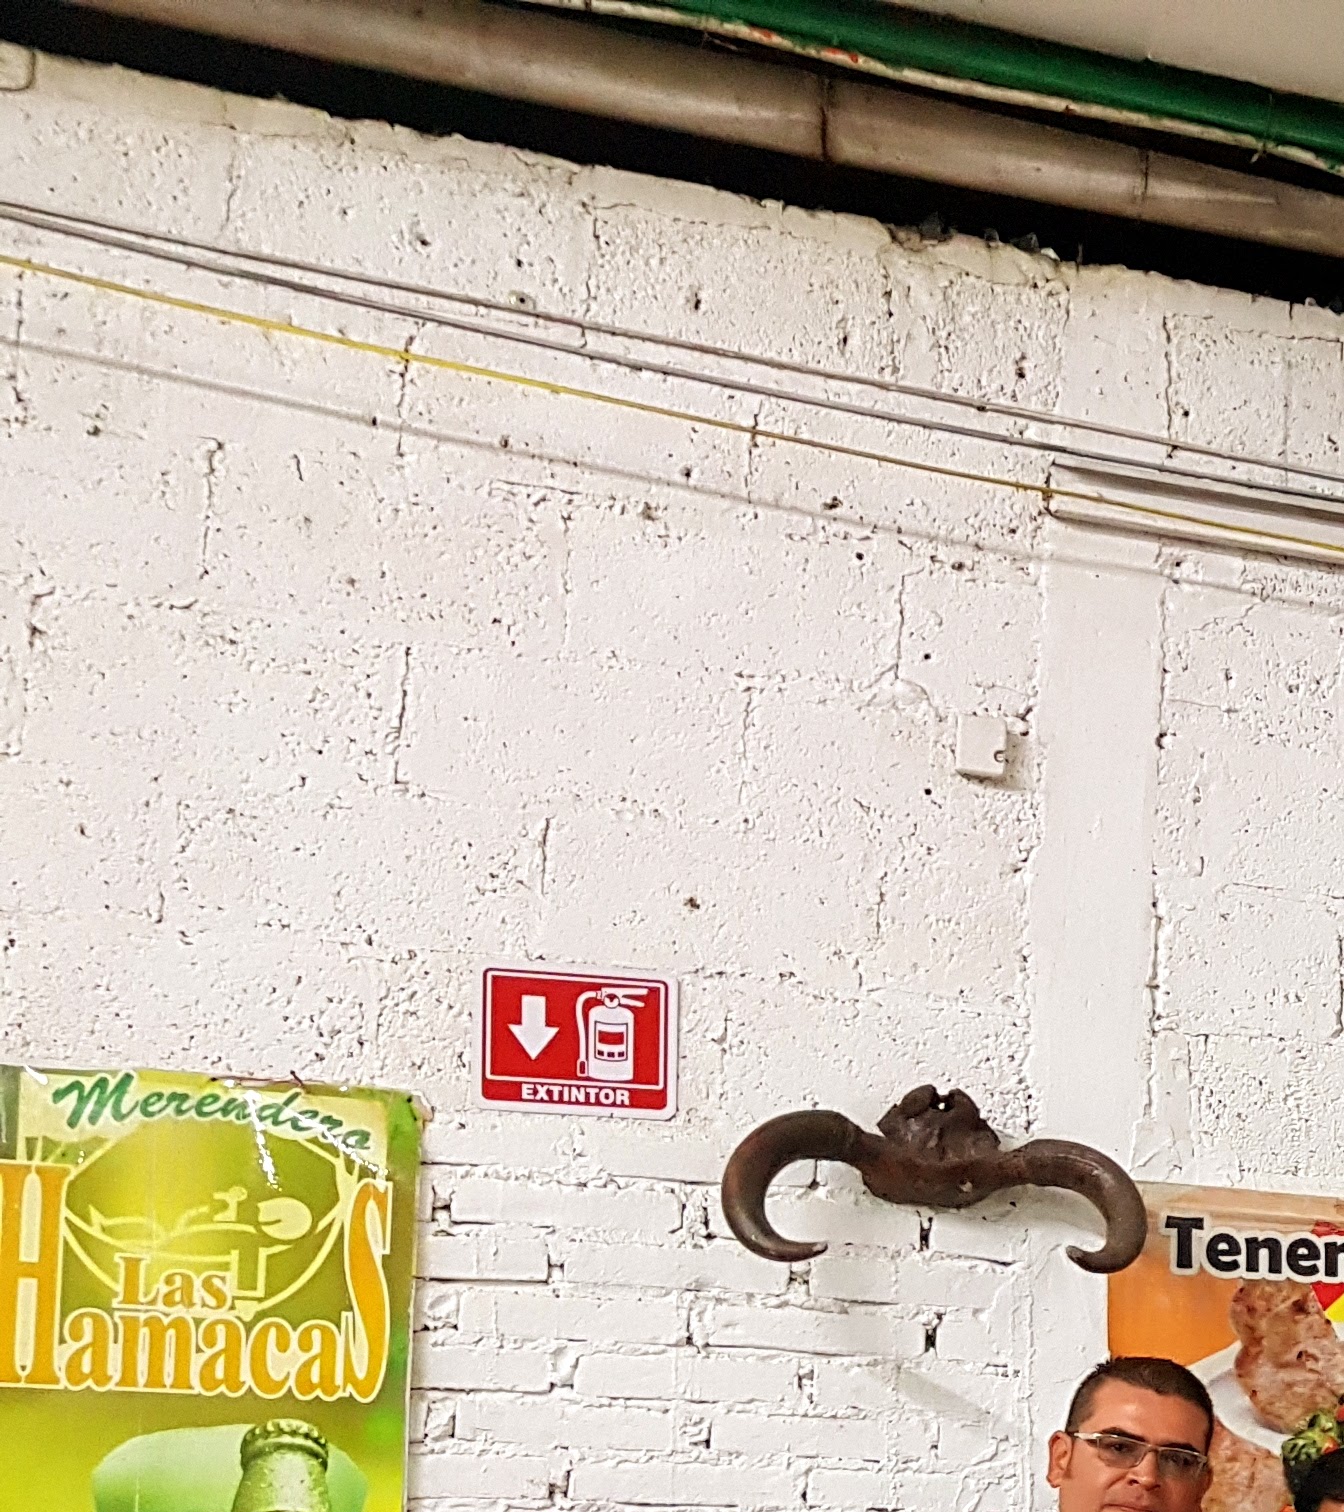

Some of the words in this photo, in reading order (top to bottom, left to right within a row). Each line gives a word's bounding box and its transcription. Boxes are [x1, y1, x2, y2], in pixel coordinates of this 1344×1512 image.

[52, 1072, 372, 1150] Merendero
[521, 1083, 630, 1106] EXTINTOR
[114, 1253, 234, 1311] Las
